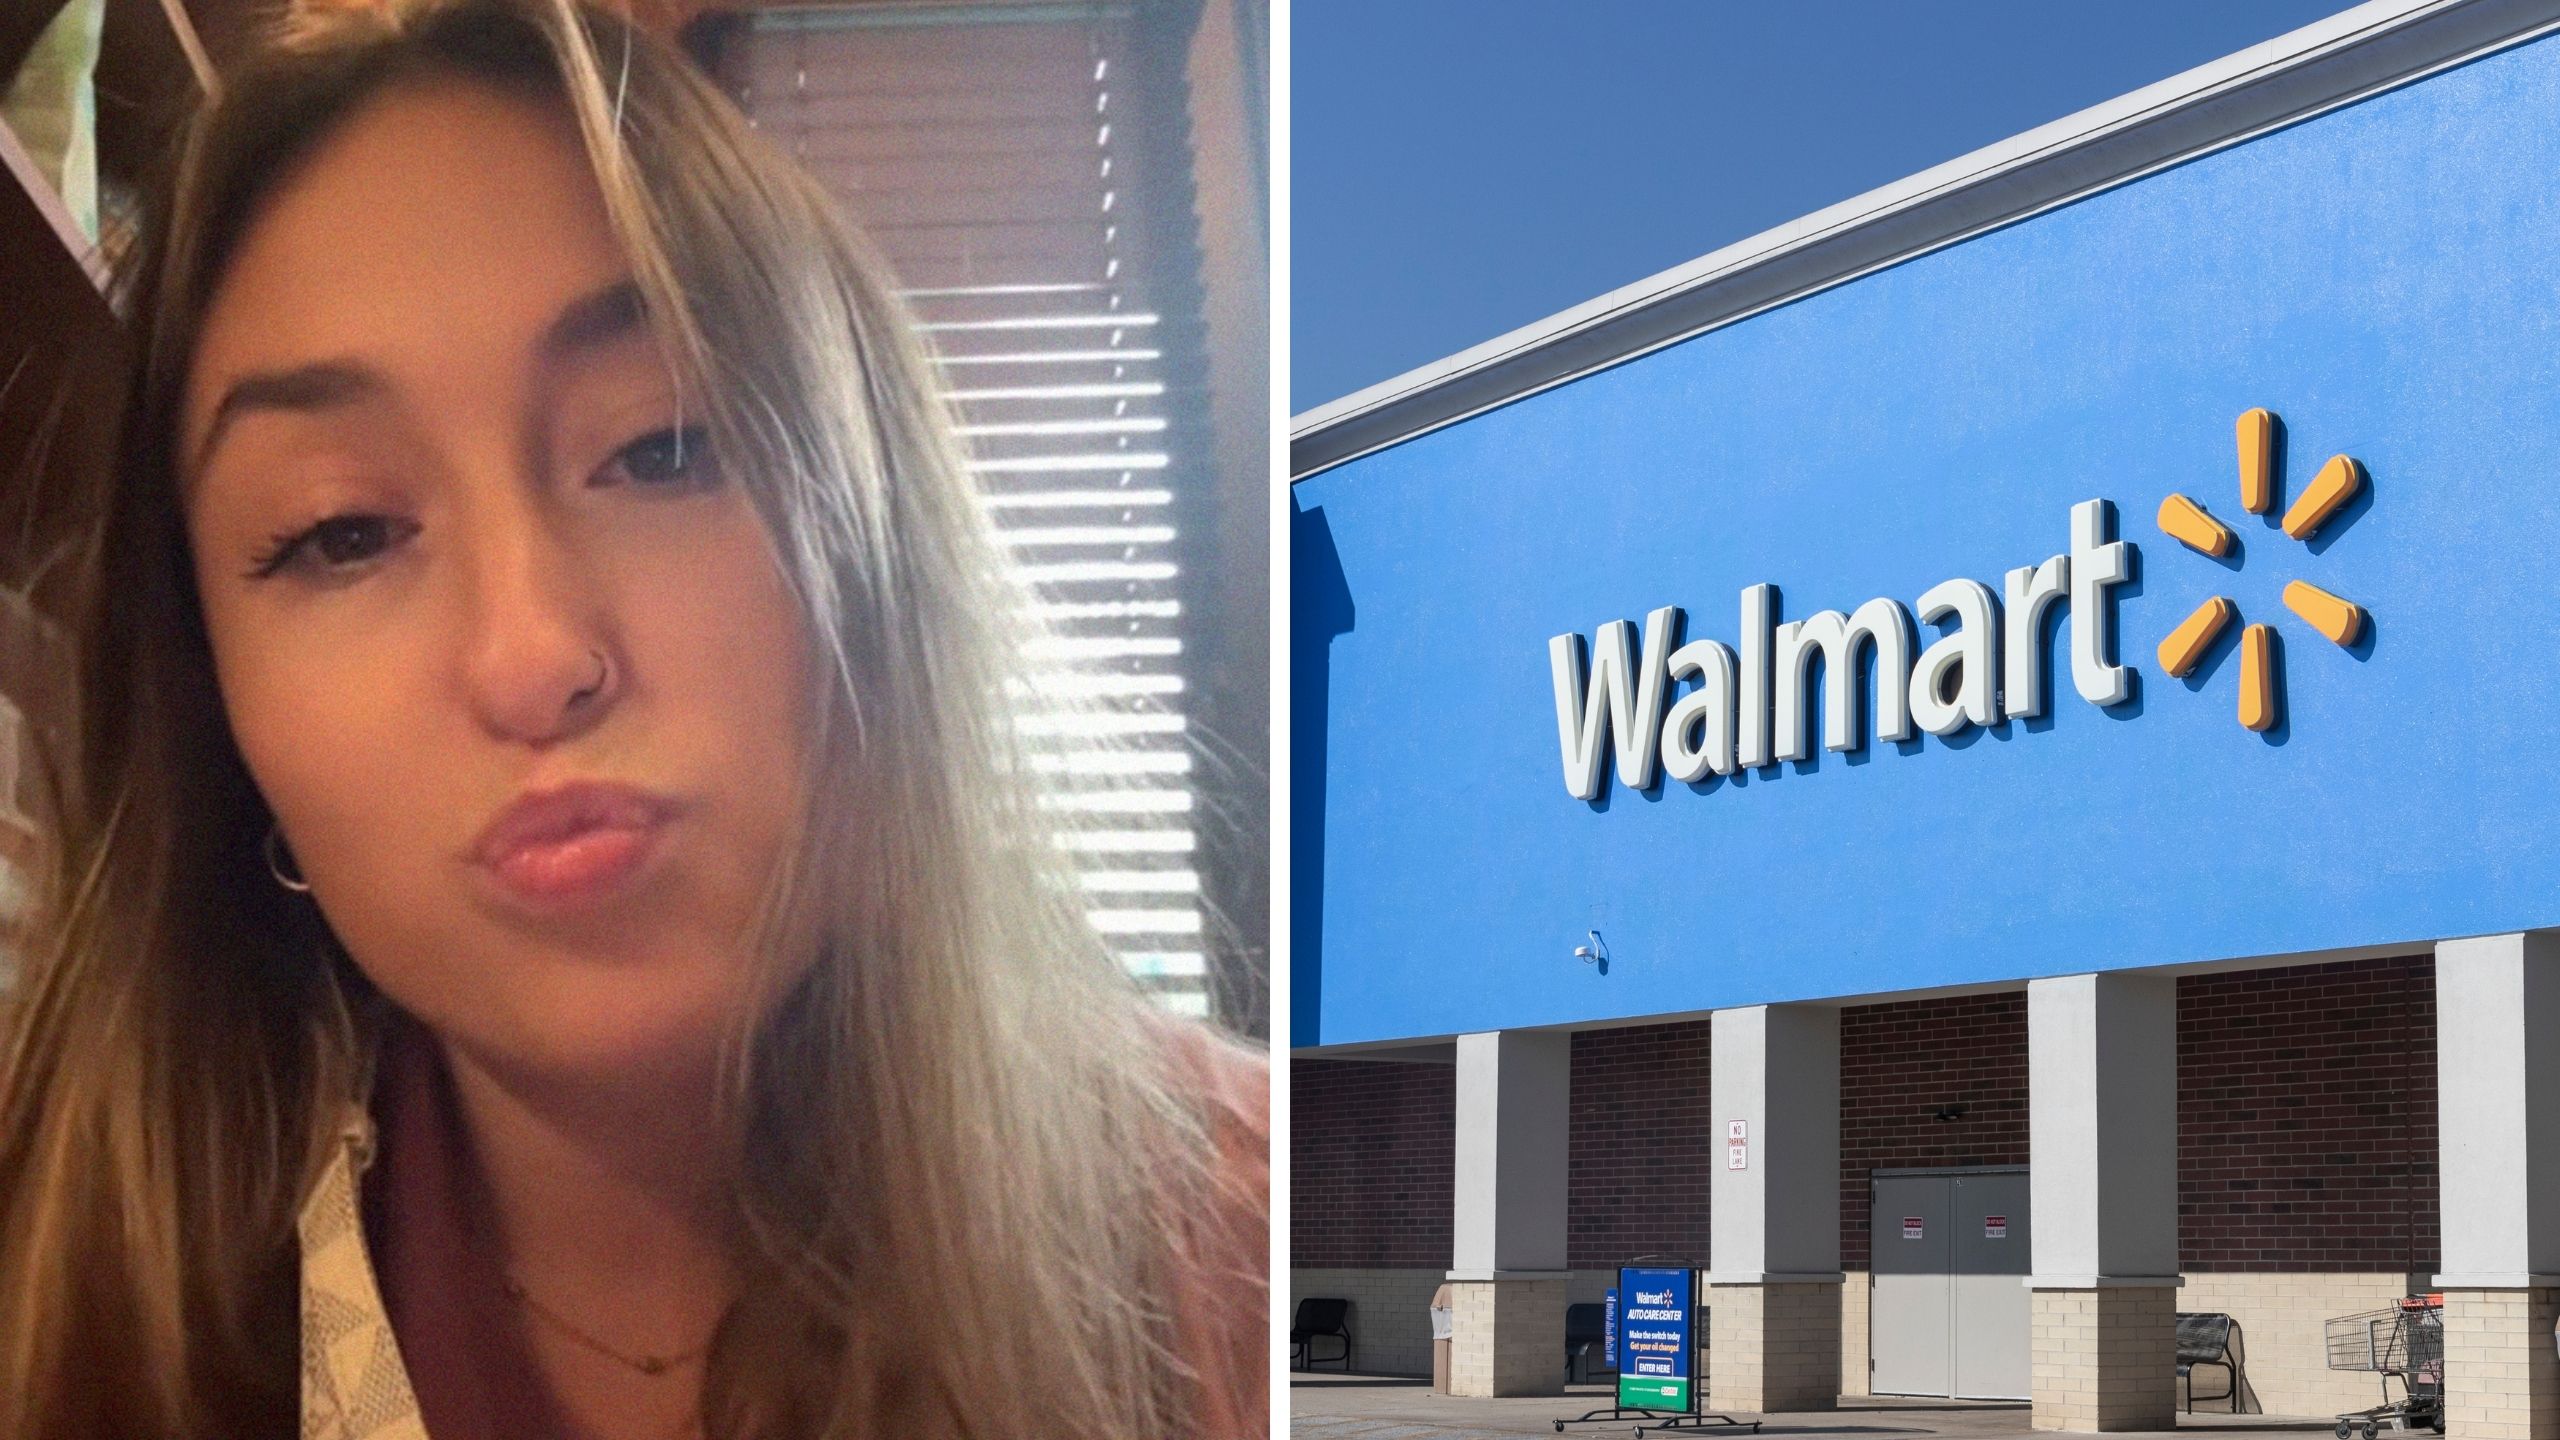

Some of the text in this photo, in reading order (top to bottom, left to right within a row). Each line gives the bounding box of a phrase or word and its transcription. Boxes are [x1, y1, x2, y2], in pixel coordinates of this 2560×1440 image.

[1549, 499, 2128, 800] Walmart
[1733, 1125, 1742, 1135] NO
[1728, 1138, 1746, 1147] PARKING
[1636, 1291, 1663, 1305] Walmart
[1627, 1309, 1682, 1321] AUTO CARE CENTER
[1629, 1330, 1680, 1342] Make the switch today
[1630, 1342, 1680, 1353] Get your oil changed
[1639, 1363, 1671, 1374] ENTER HERE
